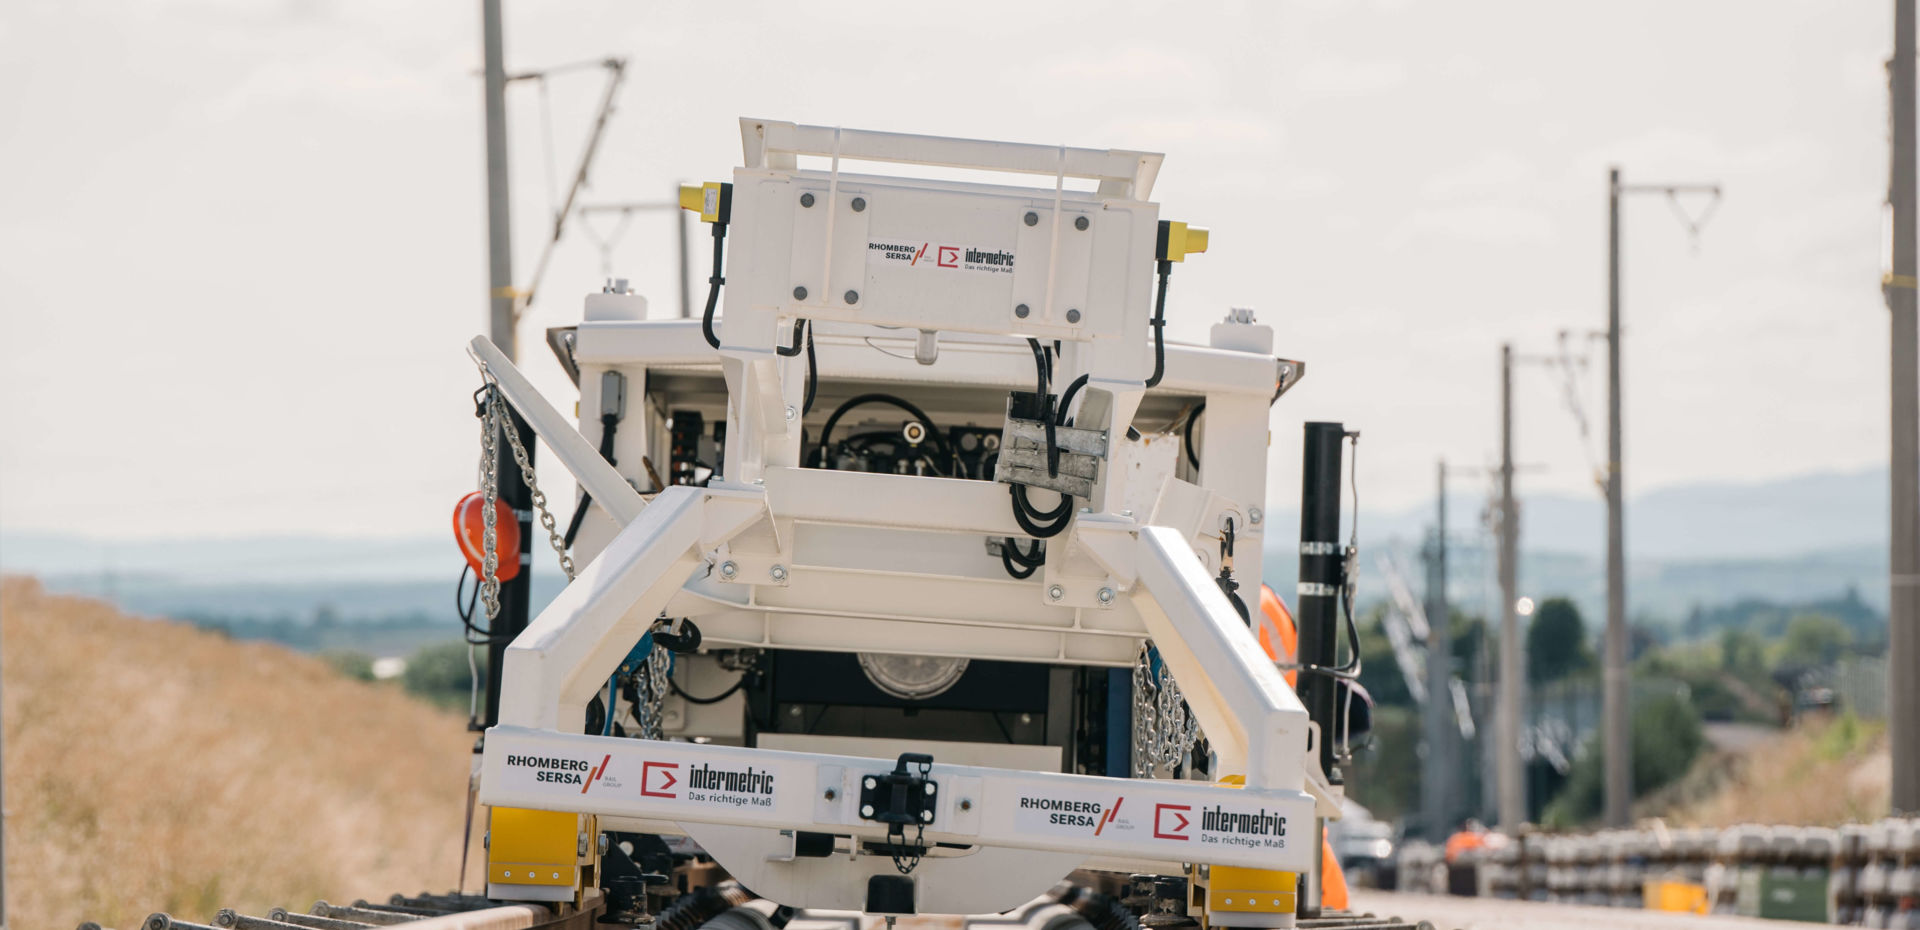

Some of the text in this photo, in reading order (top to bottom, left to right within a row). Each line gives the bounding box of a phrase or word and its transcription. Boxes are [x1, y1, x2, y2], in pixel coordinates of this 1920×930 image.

[868, 242, 916, 254] RHOMBERG
[885, 251, 912, 261] SERSA
[965, 247, 1014, 267] intermetric
[976, 265, 1000, 273] richtige
[507, 754, 589, 772] RHOMBERG
[536, 771, 582, 785] SERSA
[689, 763, 774, 795] intermetric
[689, 791, 772, 807] Das richtige Maß
[1020, 797, 1101, 814] RHOMBERG
[1049, 813, 1095, 827] SERSA
[1201, 805, 1286, 837] intermetric
[1201, 833, 1285, 849] Das richtige Maß
